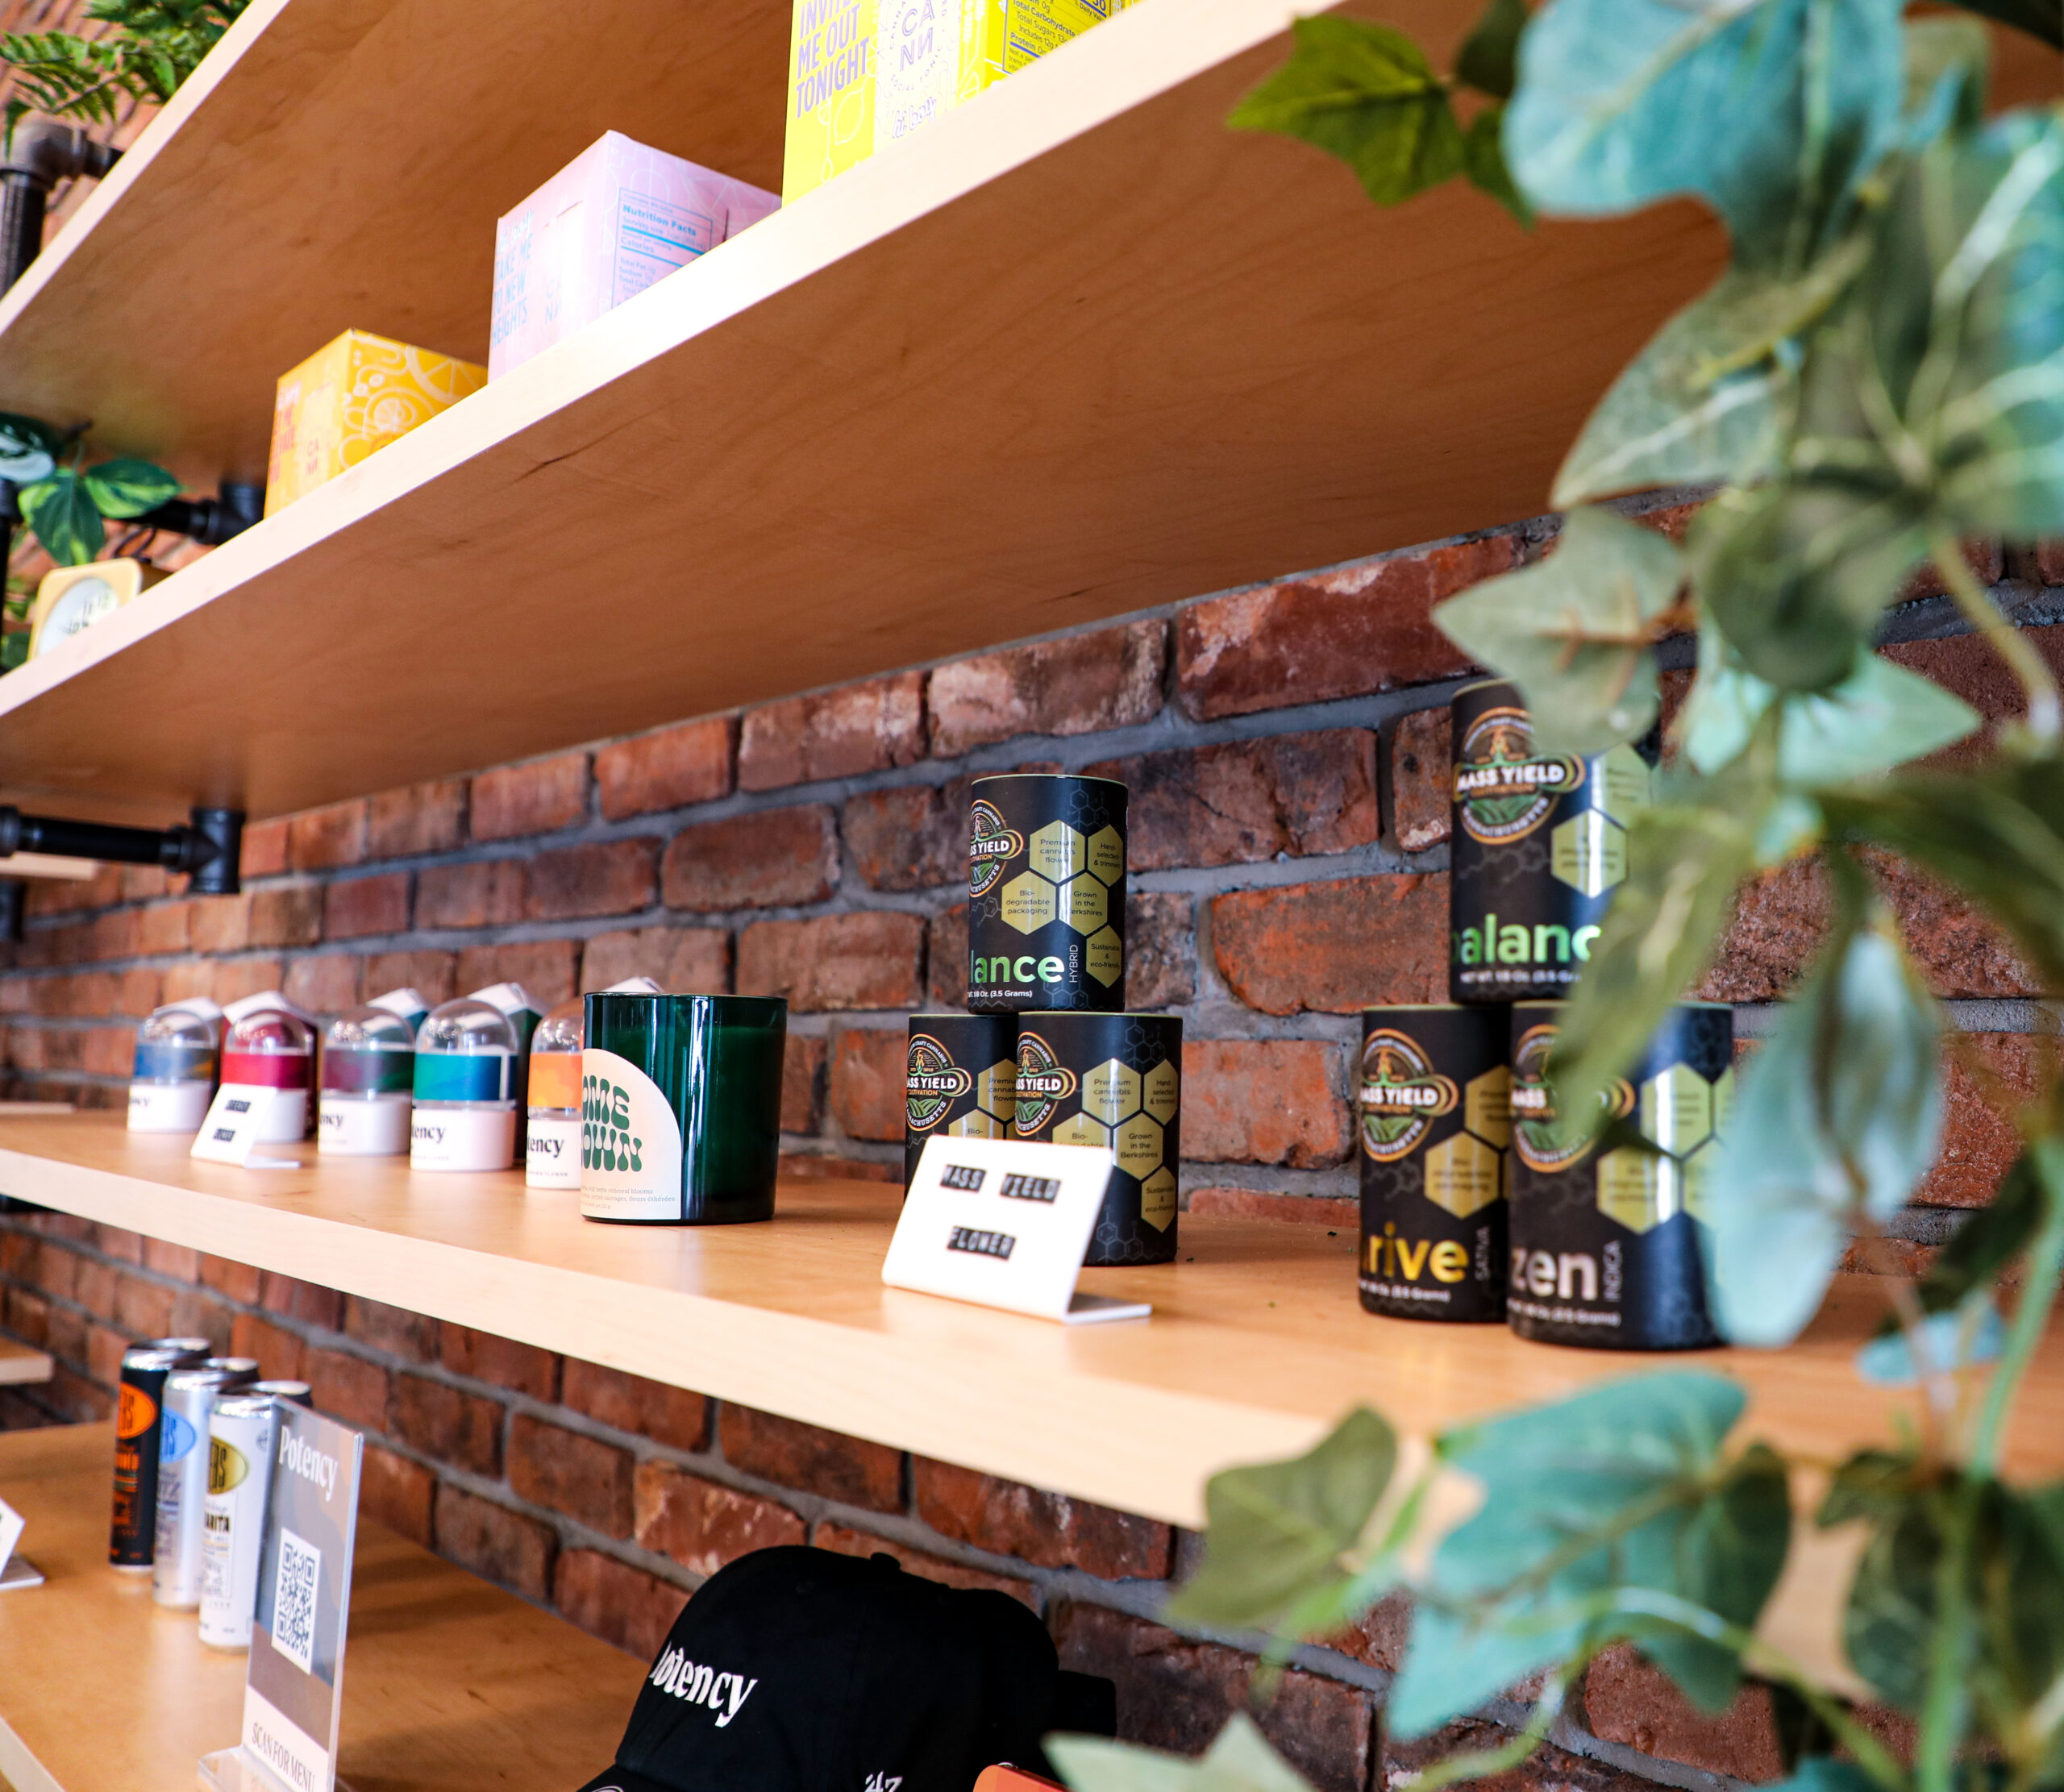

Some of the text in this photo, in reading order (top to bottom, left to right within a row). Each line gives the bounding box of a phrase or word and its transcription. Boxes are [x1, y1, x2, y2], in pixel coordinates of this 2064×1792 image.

[1017, 11, 1032, 25] Total
[1034, 20, 1055, 38] Sugars
[1019, 24, 1043, 43] Includes
[1031, 7, 1076, 37] Carbohydrate
[797, 2, 860, 80] ME OUT
[1010, 31, 1036, 51] Protein
[796, 36, 869, 118] TONIGHT
[622, 204, 697, 236] Nutrition Facts
[623, 215, 649, 231] Serving
[620, 237, 655, 253] Calories
[619, 265, 643, 278] Sodium
[492, 296, 528, 349] HEIGHTS
[1500, 764, 1565, 784] YIELD
[978, 840, 1009, 854] YIELD
[1071, 908, 1103, 917] erkshires
[1069, 944, 1079, 984] HYBRID
[990, 991, 1003, 999] (3.5
[1004, 990, 1033, 999] Grams)
[926, 1042, 947, 1063] CANNABIS
[921, 1077, 957, 1089] YIELD
[1026, 1078, 1062, 1091] YIELD
[1384, 1087, 1438, 1107] YIELD
[581, 1122, 643, 1171] OWN
[1363, 1220, 1469, 1283] rive
[1512, 1248, 1598, 1301] zen
[1603, 1240, 1622, 1303] INDICA
[278, 1424, 339, 1502] Potency
[252, 1722, 315, 1792] SCAN FOR MENU
